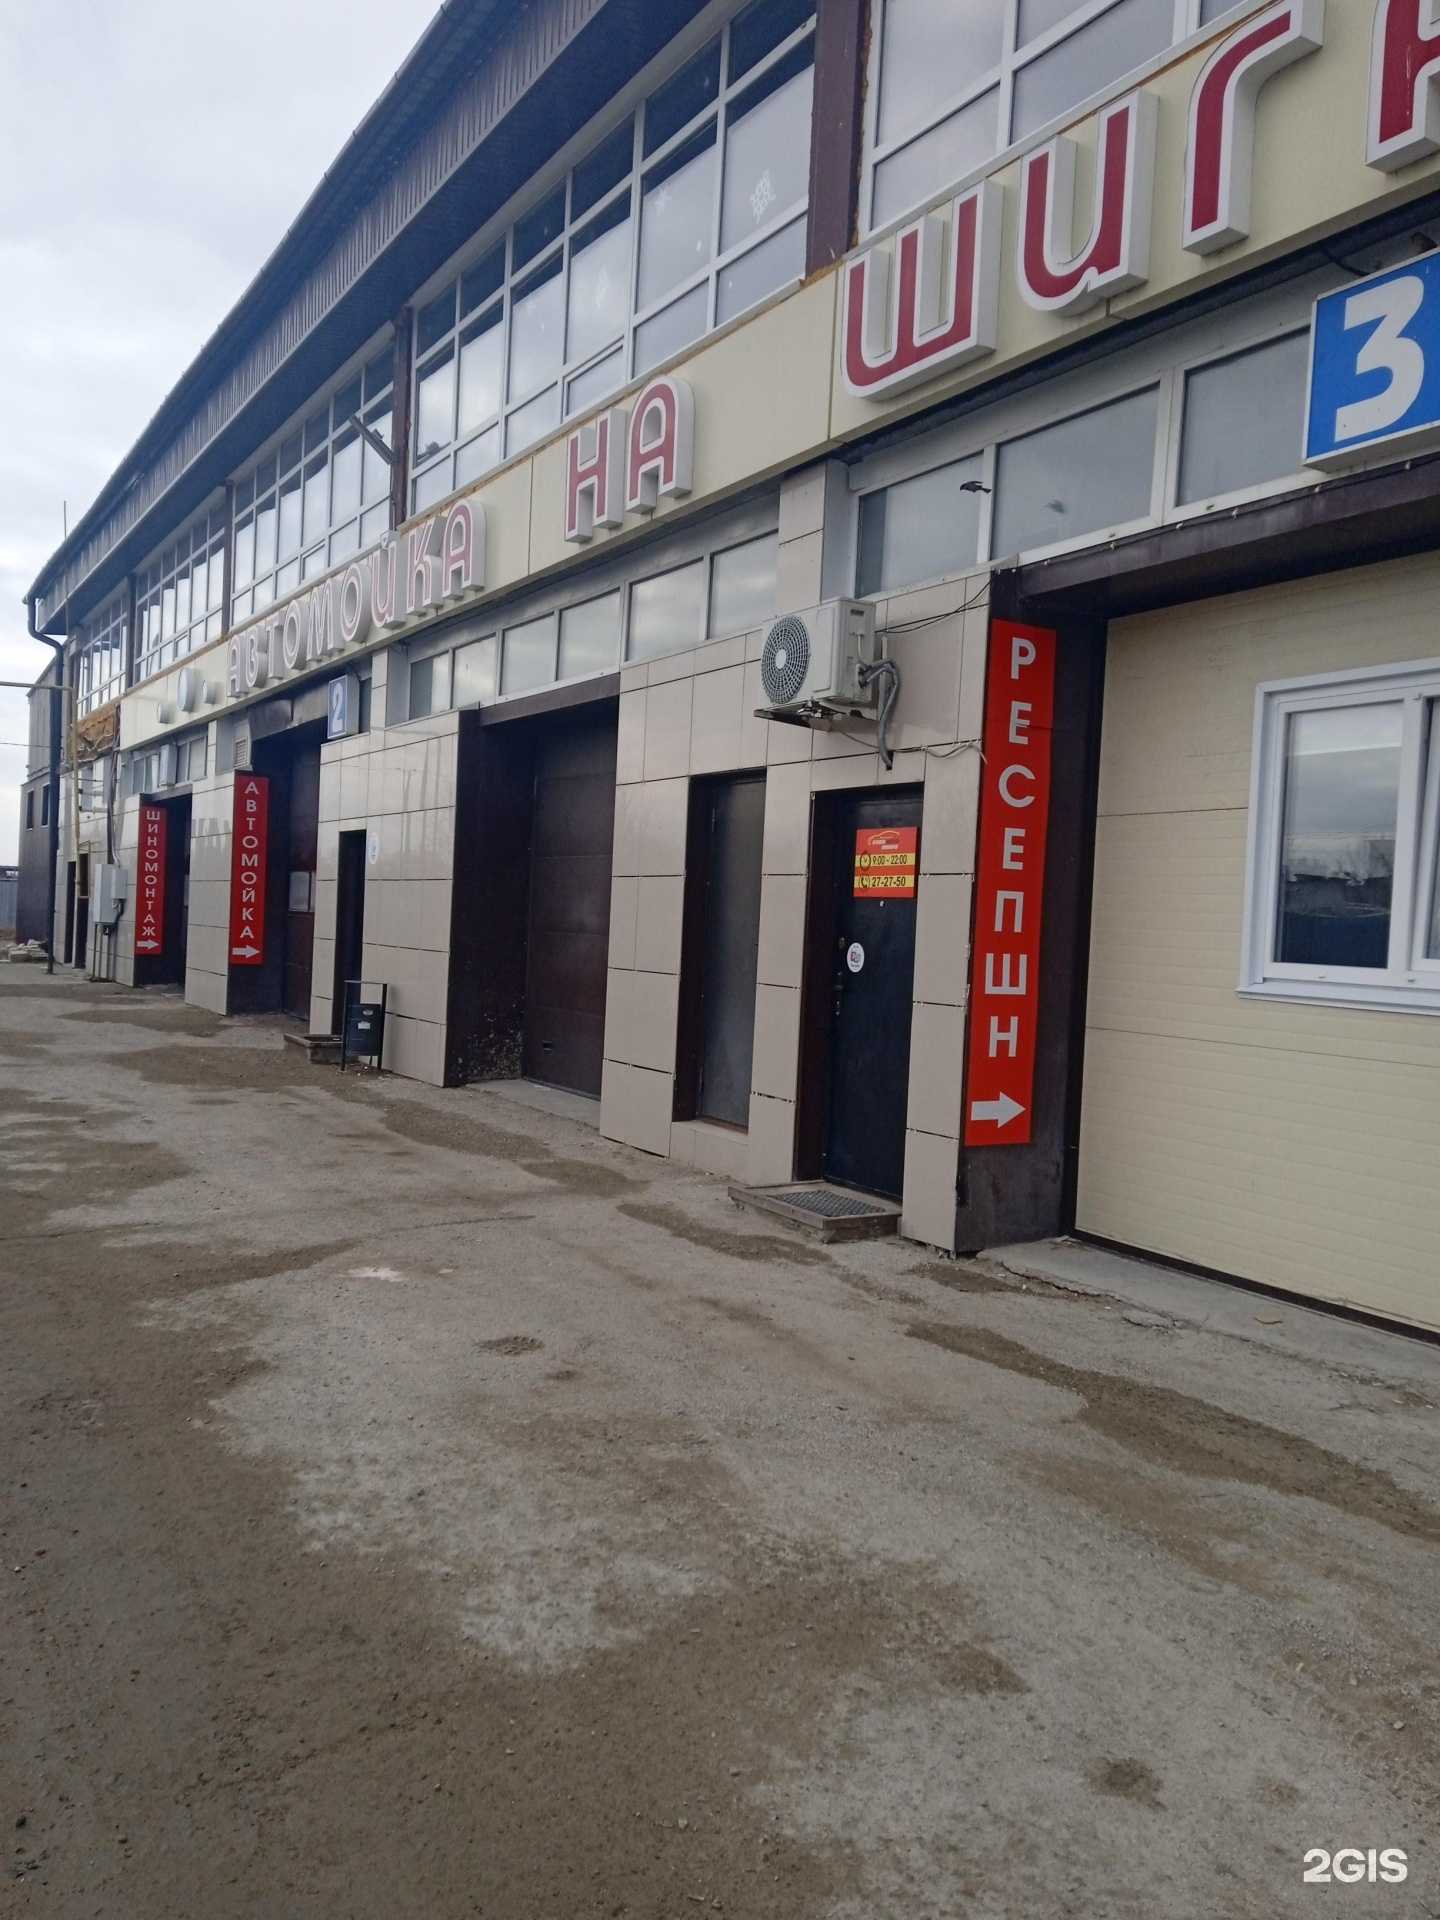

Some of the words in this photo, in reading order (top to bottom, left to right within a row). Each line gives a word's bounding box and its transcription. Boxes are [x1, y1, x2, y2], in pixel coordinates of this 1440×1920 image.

[1333, 275, 1425, 444] 3
[228, 499, 483, 698] АВТОМОЙКА
[564, 376, 692, 542] НА
[332, 682, 344, 732] 2
[141, 809, 161, 937] ШИНОМОНТАЖ
[239, 780, 260, 940] АВТОМОЙКА
[871, 876, 906, 887] 27-27-50
[984, 636, 1037, 1059] РЕСЕПШН
